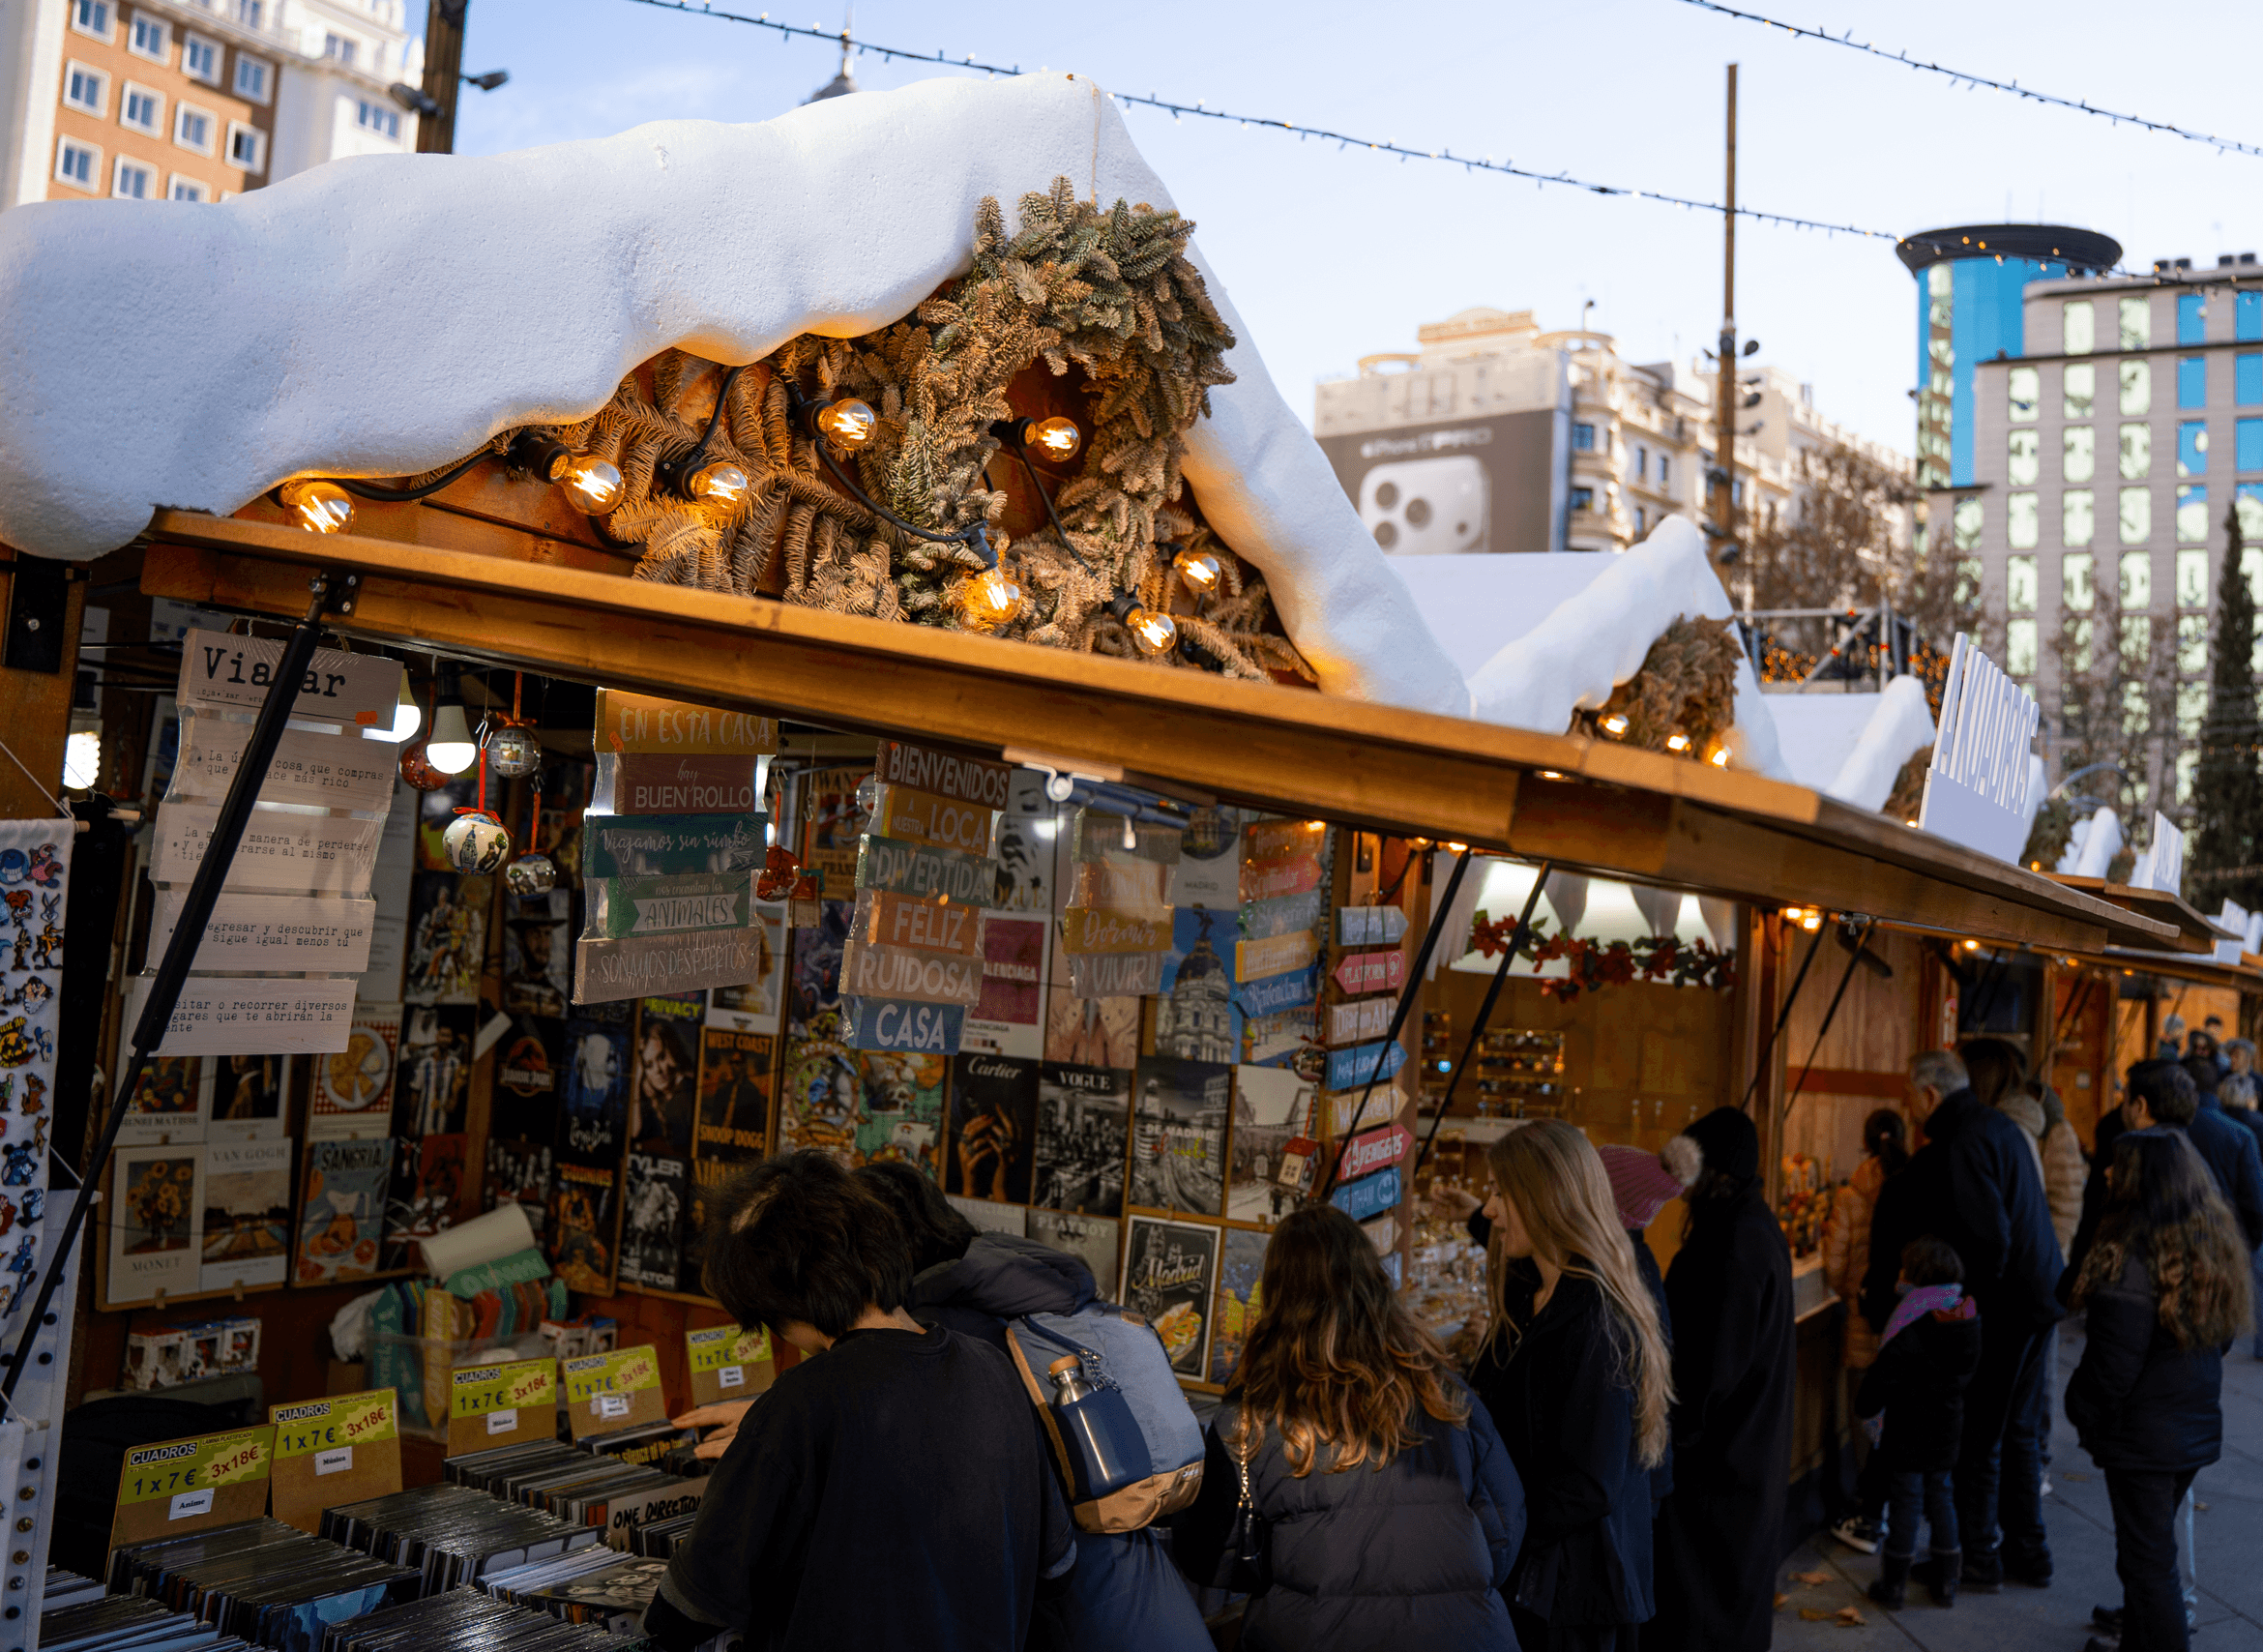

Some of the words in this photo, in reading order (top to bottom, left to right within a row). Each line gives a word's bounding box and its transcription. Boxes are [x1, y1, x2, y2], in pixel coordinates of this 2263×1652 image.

[204, 646, 345, 697] Viaar
[620, 707, 648, 743] EN
[658, 710, 710, 744] ESTA
[719, 712, 769, 746] CASA
[1930, 632, 2040, 815] AKUADROS
[207, 764, 228, 777] que
[266, 771, 286, 782] ace
[294, 771, 314, 784] más
[322, 776, 349, 788] rico
[209, 751, 222, 762] La
[276, 758, 303, 771] cosa
[310, 763, 331, 777] que
[338, 766, 384, 781] compras
[677, 759, 699, 792] hay
[888, 743, 1008, 807] BIENVENIDOS
[634, 785, 686, 809] BUEN
[692, 785, 752, 809] ROLLO
[907, 797, 915, 812] A
[892, 814, 925, 836] NUESTRA
[928, 803, 985, 850] LOCA
[182, 841, 189, 851] y
[282, 847, 295, 858] al
[302, 849, 336, 860] mismo
[185, 827, 198, 838] La
[250, 834, 291, 846] manera
[297, 836, 311, 847] de
[317, 839, 369, 852] perderse
[601, 828, 675, 864] Viajamos
[679, 833, 701, 851] sin
[874, 844, 988, 901] DIVERTIDA
[645, 897, 728, 929] ANIMALES
[893, 901, 965, 950] FELIZ
[207, 923, 256, 935] egresar
[263, 926, 271, 936] y
[278, 924, 338, 936] descubrir
[343, 928, 364, 940] que
[213, 934, 248, 946] sigue
[256, 933, 289, 946] igual
[296, 936, 330, 947] menos
[337, 936, 349, 947] tú
[1083, 910, 1162, 948] Dormir
[601, 950, 666, 984] SOÑAMOS
[667, 943, 748, 976] DESPIERTOS
[857, 951, 975, 1001] RUIDOSA
[171, 1012, 209, 1023] gares
[216, 1012, 238, 1022] que
[246, 1011, 259, 1021] te
[265, 1008, 314, 1021] abrirán
[320, 1010, 333, 1020] la
[174, 1000, 211, 1010] sitar
[231, 1001, 289, 1011] recorrer
[294, 1000, 347, 1012] diversos
[165, 1022, 192, 1032] ente
[875, 1004, 946, 1050] CASA
[706, 1030, 736, 1049] WEST
[736, 1034, 773, 1055] COAST
[968, 1054, 1023, 1079] Cartier
[1058, 1070, 1111, 1091] VOGUE
[699, 1124, 734, 1144] SNOOP
[734, 1128, 765, 1149] DOGG
[1145, 1122, 1162, 1136] DE
[1165, 1125, 1218, 1141] MADRID
[212, 1149, 242, 1164] VAN
[245, 1145, 287, 1162] GOGH
[320, 1146, 383, 1171] SANGRIA
[627, 1153, 684, 1178] TYLER
[1344, 1133, 1404, 1178] AVENGERS
[1037, 1215, 1108, 1238] PLAYBOY
[131, 1256, 182, 1273] MONET
[1131, 1254, 1206, 1290] Madrid
[454, 1368, 501, 1385] CUADROS
[513, 1373, 548, 1401] 3x18€
[574, 1383, 581, 1397] 1
[585, 1384, 593, 1395] x
[595, 1378, 602, 1393] 7
[605, 1376, 614, 1391] €
[460, 1396, 466, 1411] 1
[472, 1398, 480, 1409] x
[485, 1393, 491, 1407] 7
[495, 1390, 504, 1405] €
[276, 1403, 331, 1423] CUADROS
[345, 1407, 388, 1437] 3x18€
[282, 1434, 290, 1452] 1
[297, 1436, 307, 1449] x
[311, 1430, 321, 1446] 7
[325, 1427, 336, 1444] €
[130, 1442, 197, 1465] CUADROS
[211, 1445, 260, 1479] 3x18€
[322, 1454, 346, 1466] Música
[134, 1478, 143, 1496] 1
[149, 1479, 162, 1493] x
[168, 1471, 180, 1490] 7
[184, 1467, 197, 1486] €
[178, 1497, 206, 1510] Anime
[613, 1506, 640, 1529] ONE
